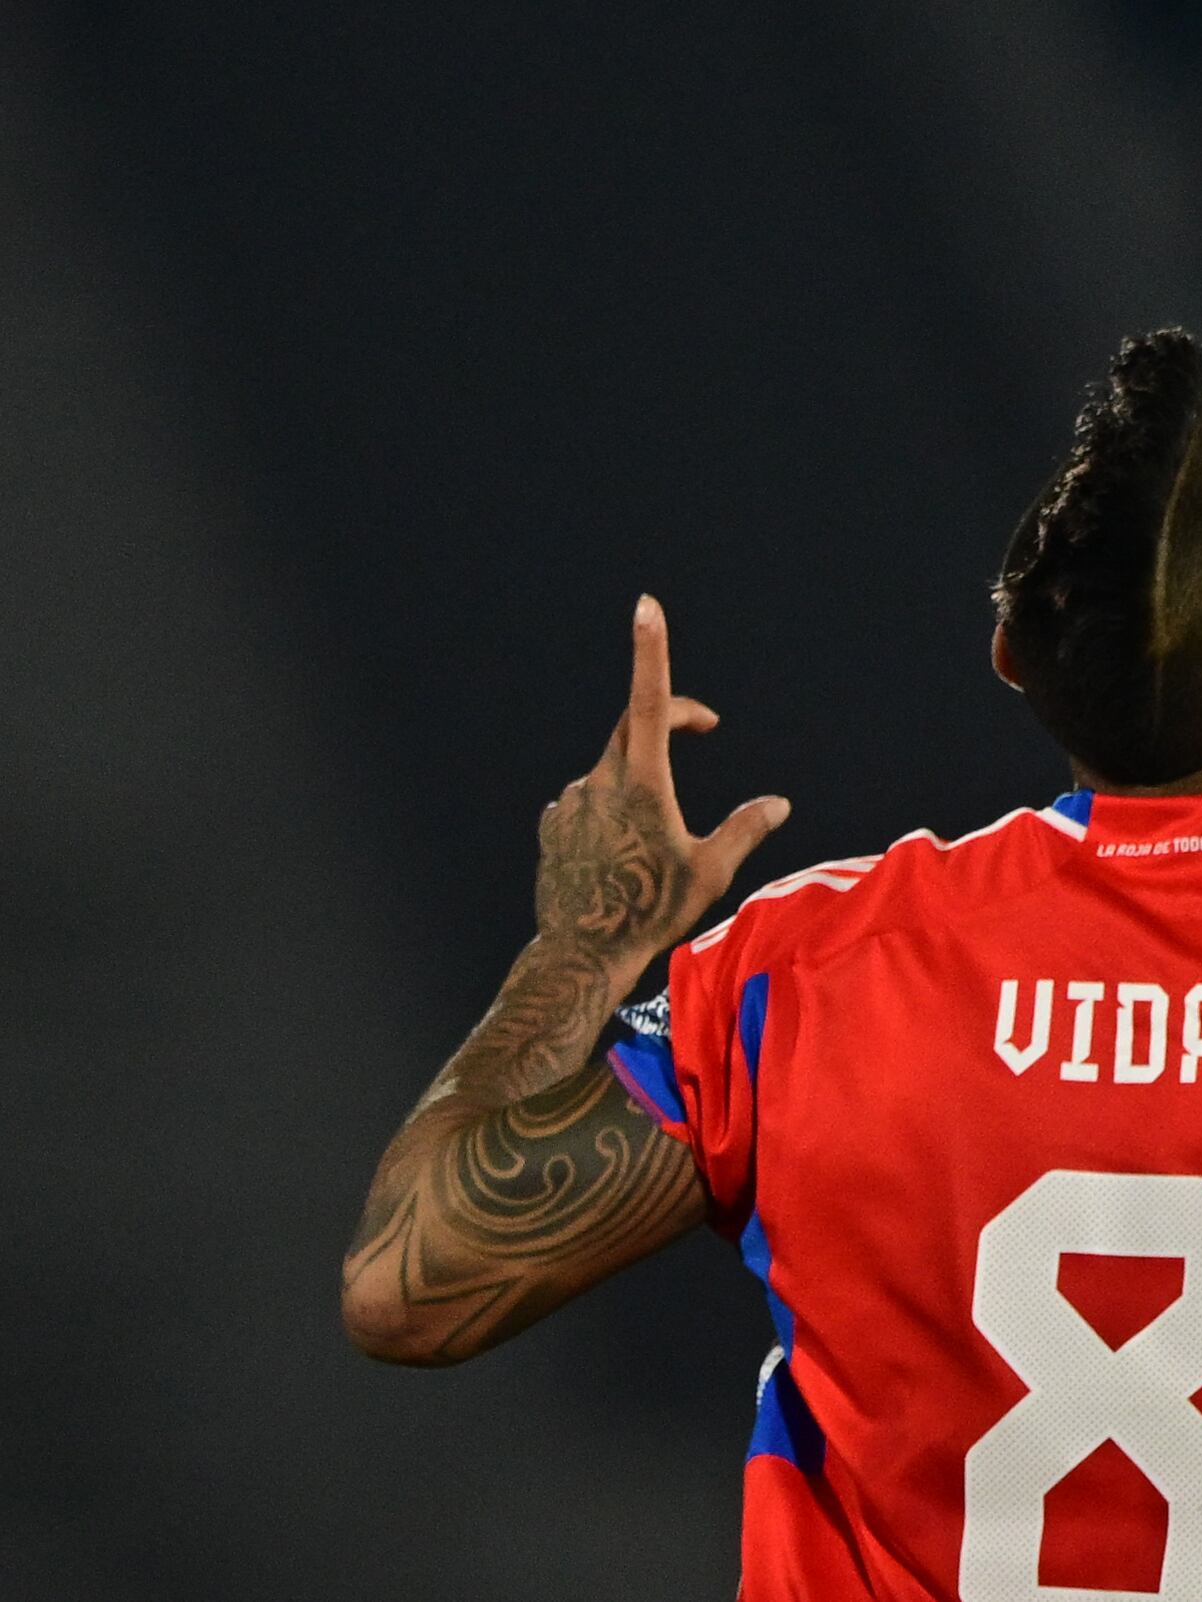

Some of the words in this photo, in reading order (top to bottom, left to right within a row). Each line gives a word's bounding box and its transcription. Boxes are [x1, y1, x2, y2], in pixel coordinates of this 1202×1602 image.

[1096, 844, 1116, 857] LA
[1116, 843, 1153, 857] ROJA
[1152, 841, 1170, 855] DE
